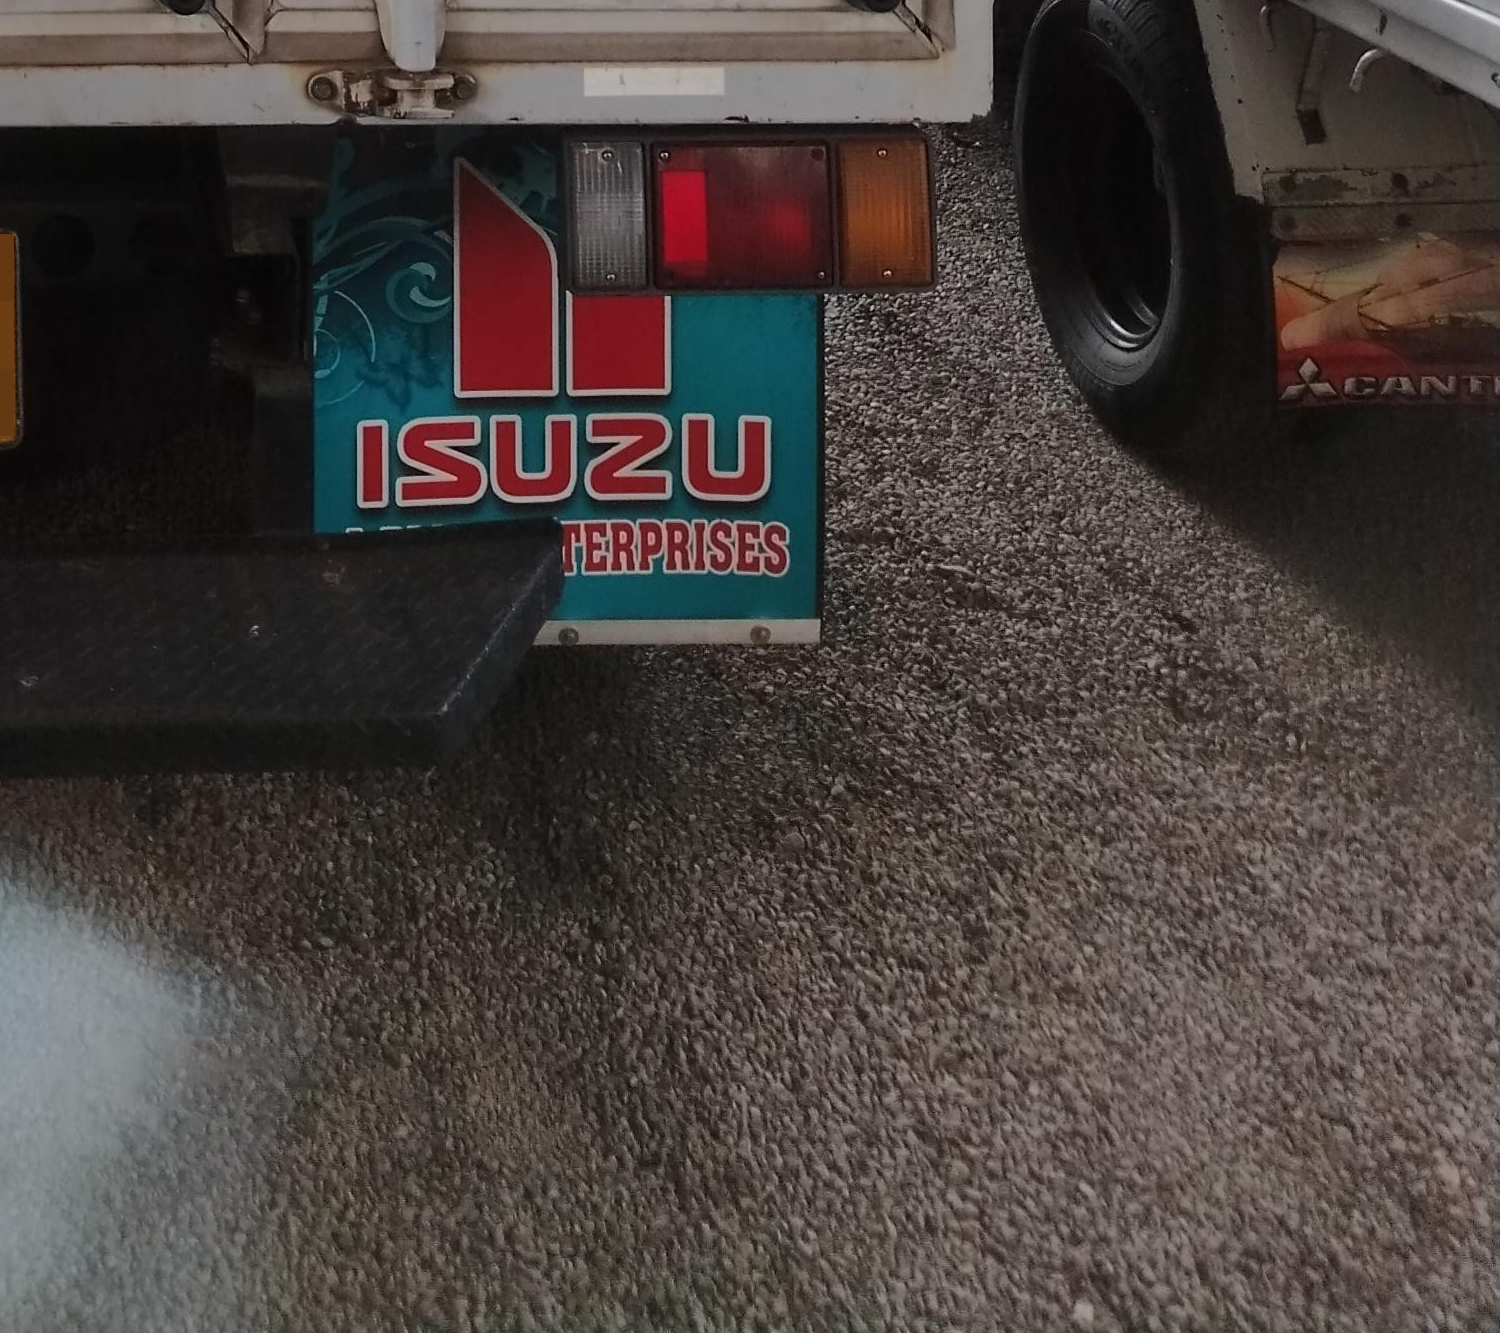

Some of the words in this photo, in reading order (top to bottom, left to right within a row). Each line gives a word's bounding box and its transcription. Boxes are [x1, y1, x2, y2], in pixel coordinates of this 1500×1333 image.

[1343, 376, 1500, 398] CANT
[356, 413, 772, 509] ISUZU
[560, 519, 791, 578] TERPRISES
